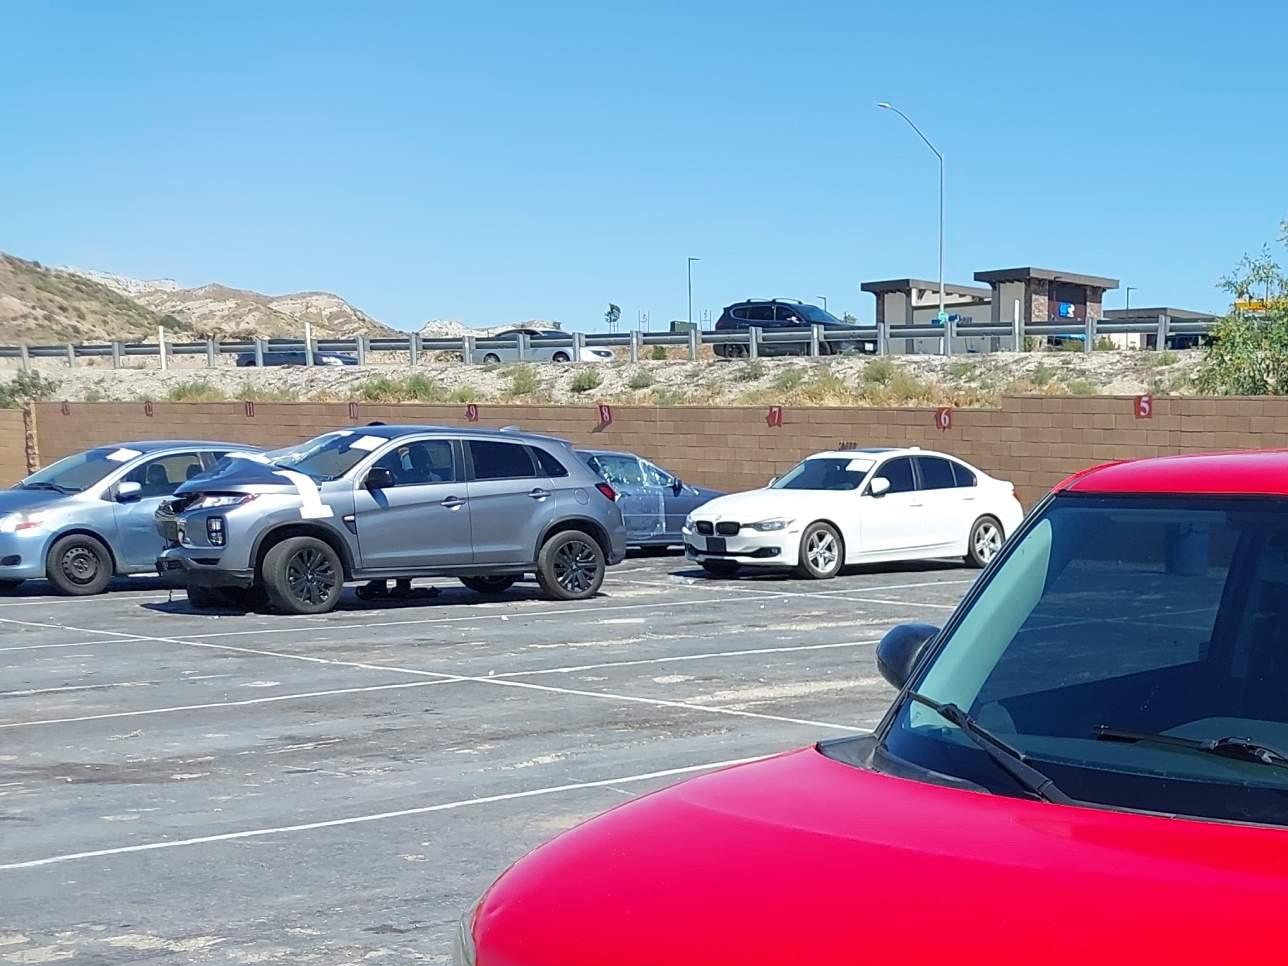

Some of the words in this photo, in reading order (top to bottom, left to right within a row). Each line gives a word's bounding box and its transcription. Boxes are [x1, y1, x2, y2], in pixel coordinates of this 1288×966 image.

[601, 406, 610, 422] 8
[1140, 396, 1149, 416] 5
[940, 409, 950, 426] 6
